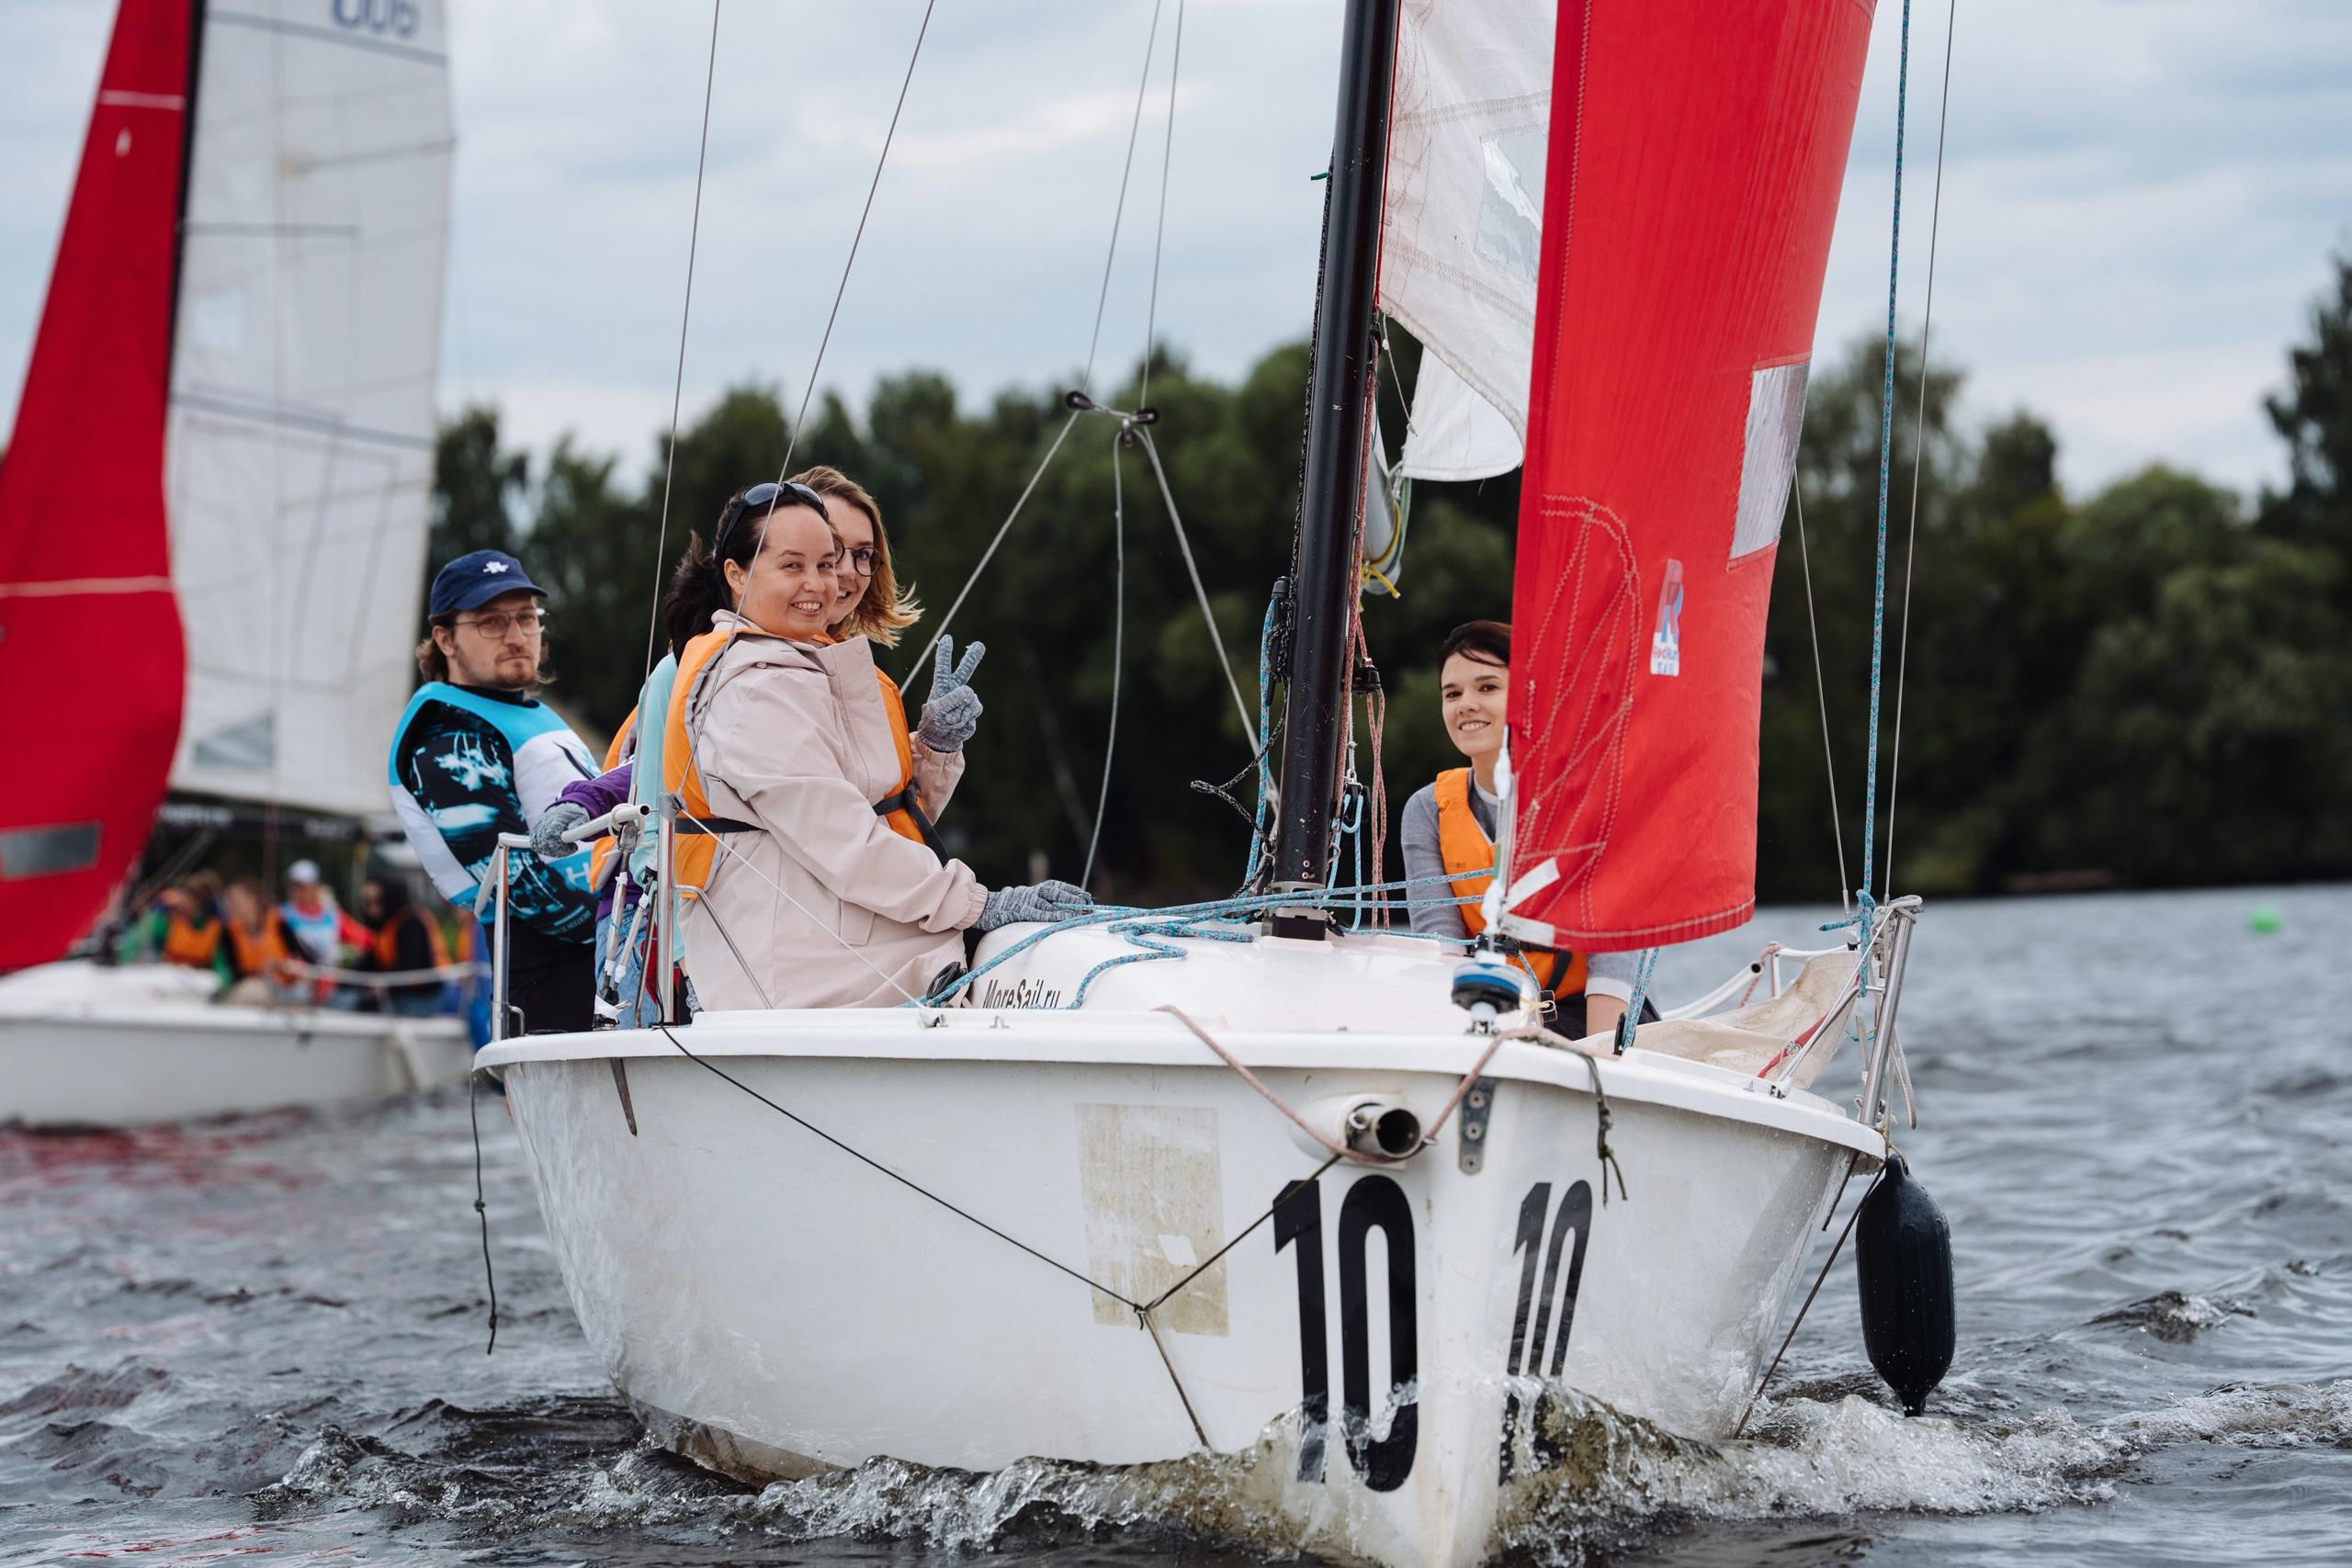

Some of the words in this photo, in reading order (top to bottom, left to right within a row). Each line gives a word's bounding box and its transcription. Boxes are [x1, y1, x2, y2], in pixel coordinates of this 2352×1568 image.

[981, 978, 1061, 1010] MoreSailru
[1272, 1175, 1419, 1493] 10
[1498, 1179, 1593, 1486] 10
